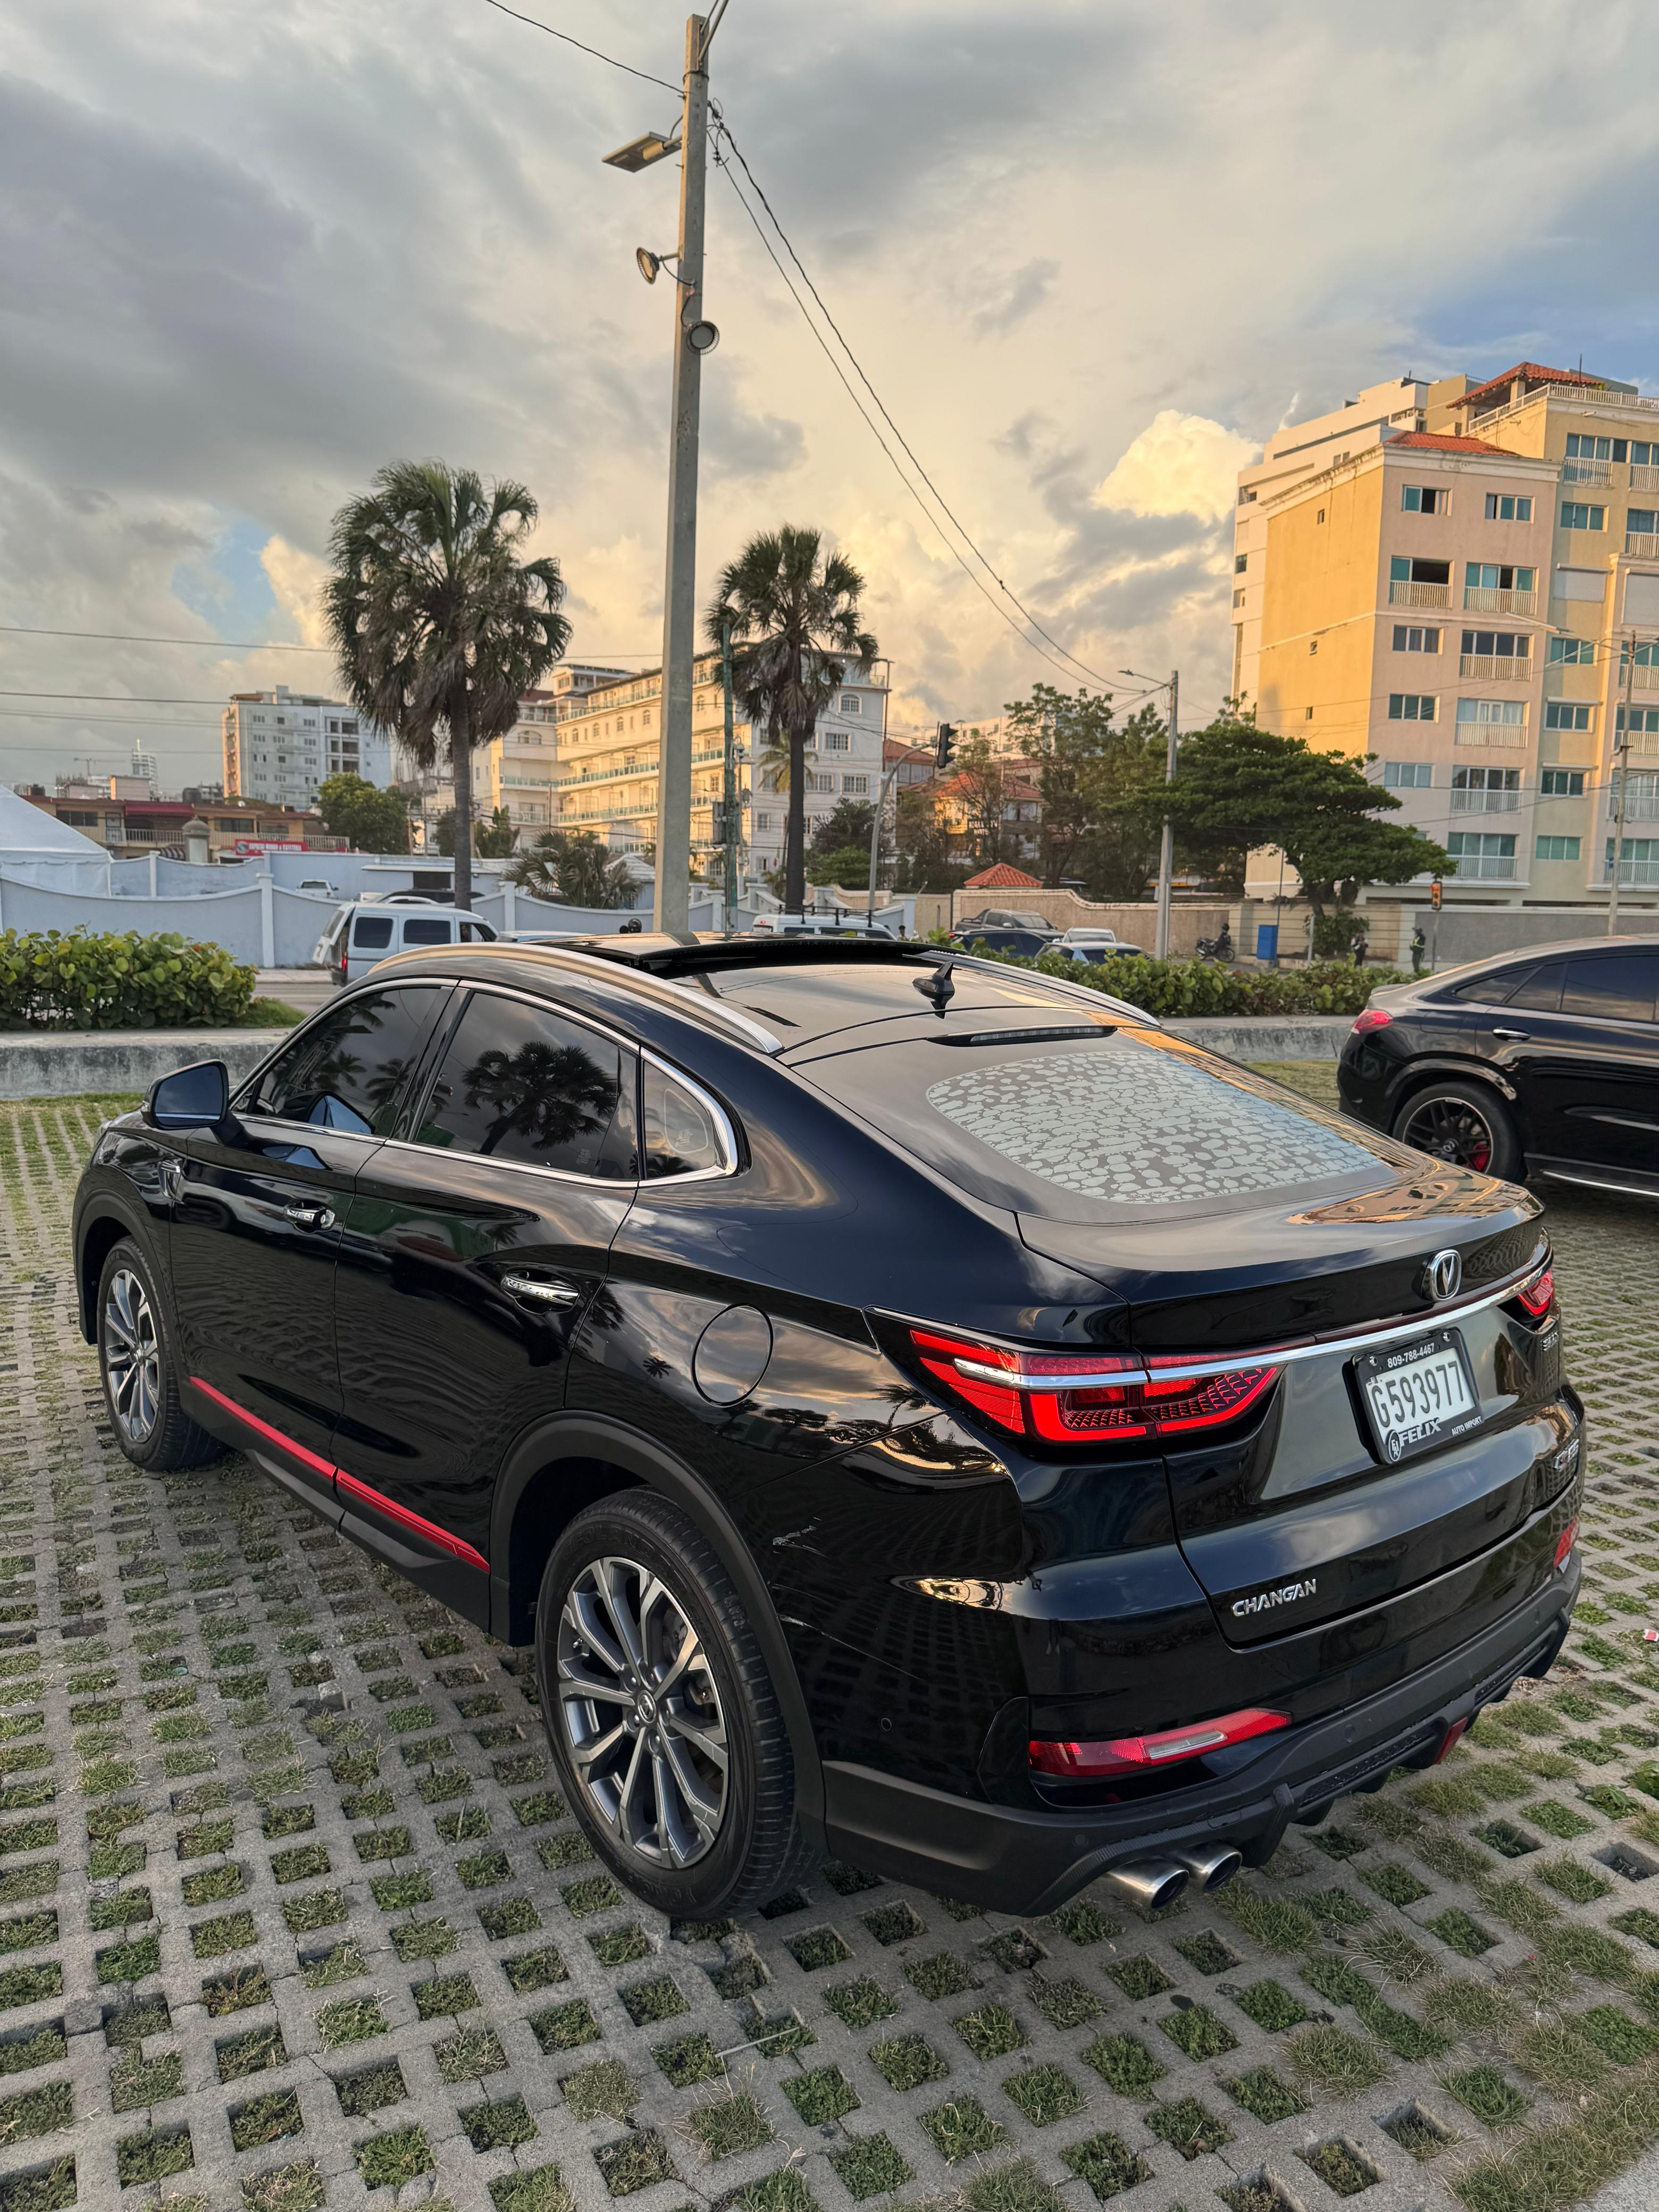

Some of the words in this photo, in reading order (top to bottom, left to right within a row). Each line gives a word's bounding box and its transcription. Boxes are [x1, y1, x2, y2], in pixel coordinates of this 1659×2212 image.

[1387, 1343, 1434, 1368] 809-788-4467
[1371, 1360, 1464, 1428] G593977
[1398, 1419, 1442, 1447] FELIX
[1452, 1426, 1464, 1436] AUTO
[1464, 1416, 1482, 1431] IMPORT
[1231, 1578, 1316, 1617] CHANGAN
